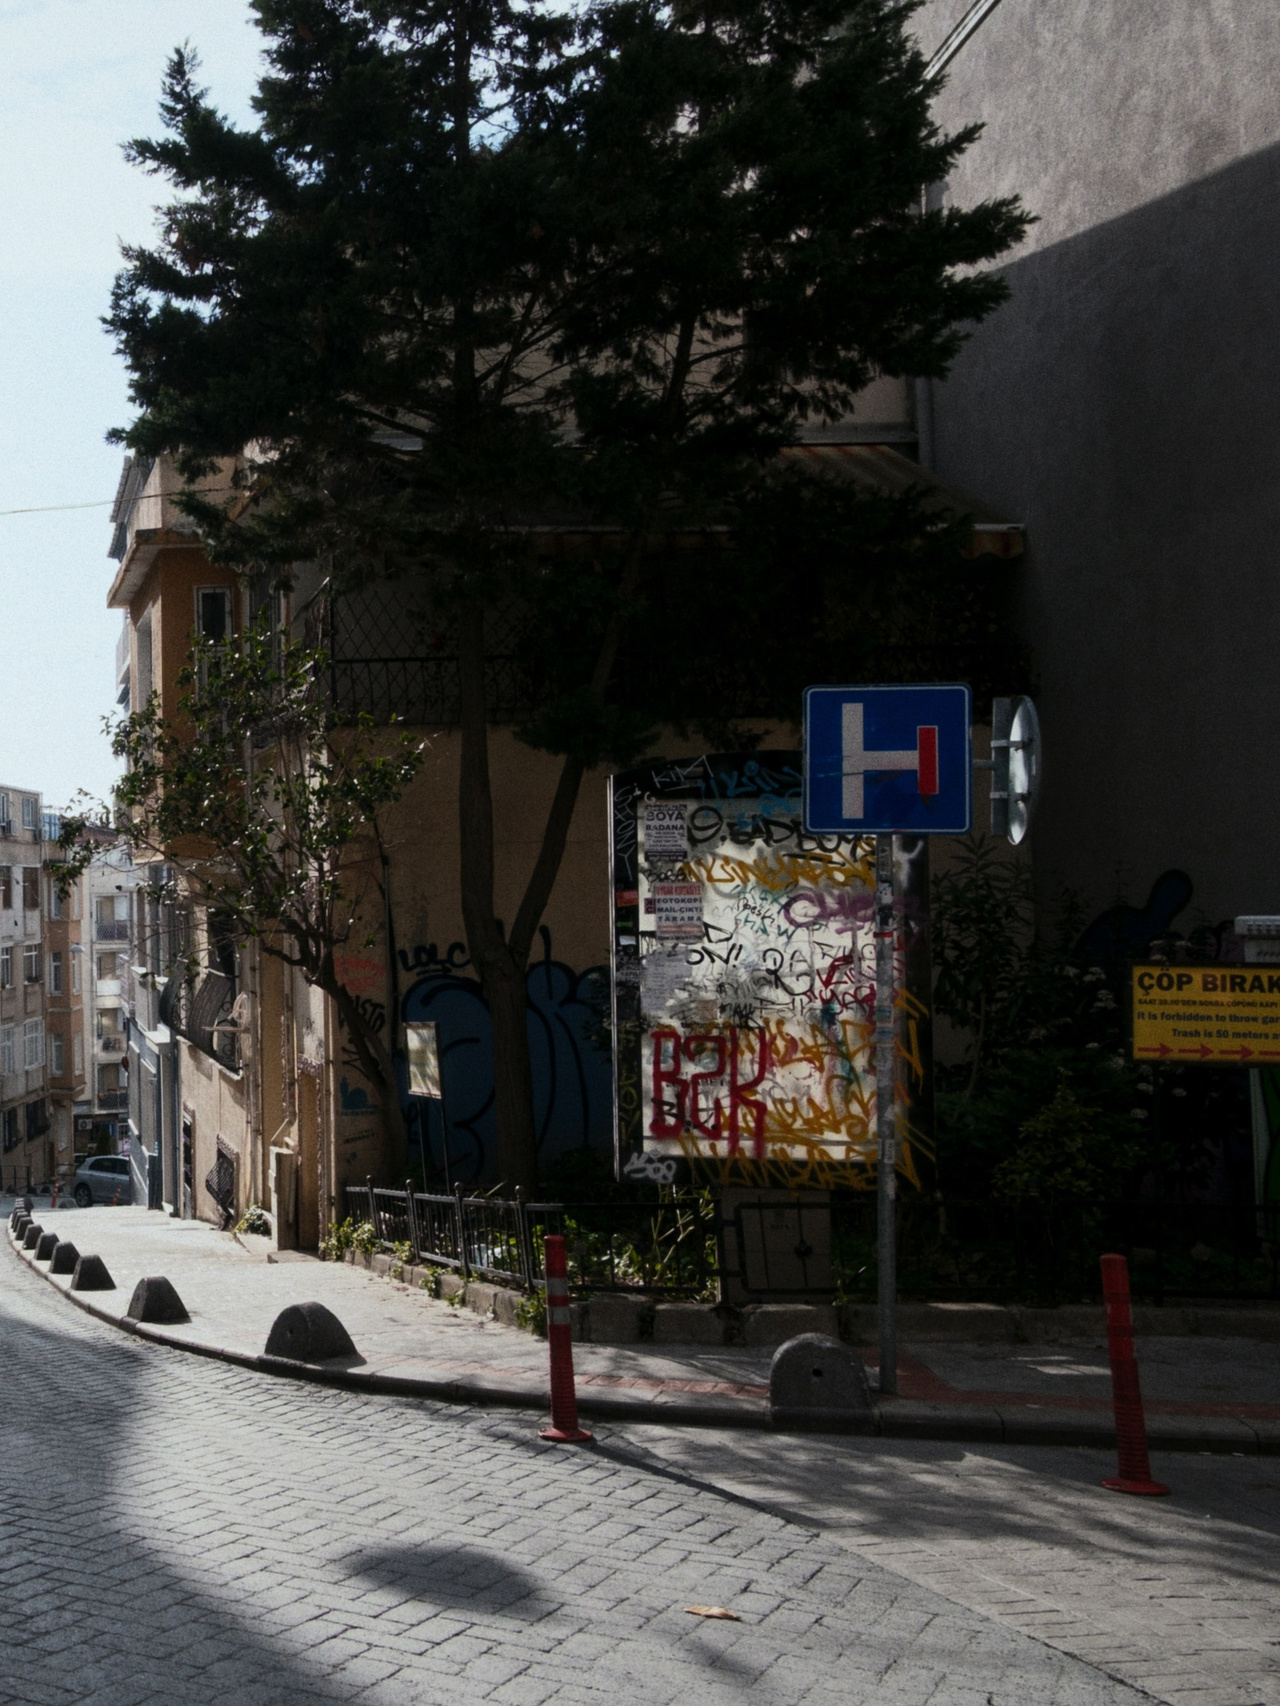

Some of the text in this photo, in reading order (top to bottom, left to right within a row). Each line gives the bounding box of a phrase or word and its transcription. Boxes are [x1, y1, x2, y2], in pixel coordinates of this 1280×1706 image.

[646, 811, 684, 821] BOYA
[1138, 968, 1193, 996] ÇÖP
[1161, 1012, 1213, 1022] forbidden
[1215, 1014, 1227, 1022] to
[1229, 1014, 1259, 1023] throw
[1172, 1028, 1201, 1038] Trash
[1204, 1029, 1213, 1038] is
[1217, 1030, 1229, 1038] 50
[1232, 1030, 1270, 1040] meters
